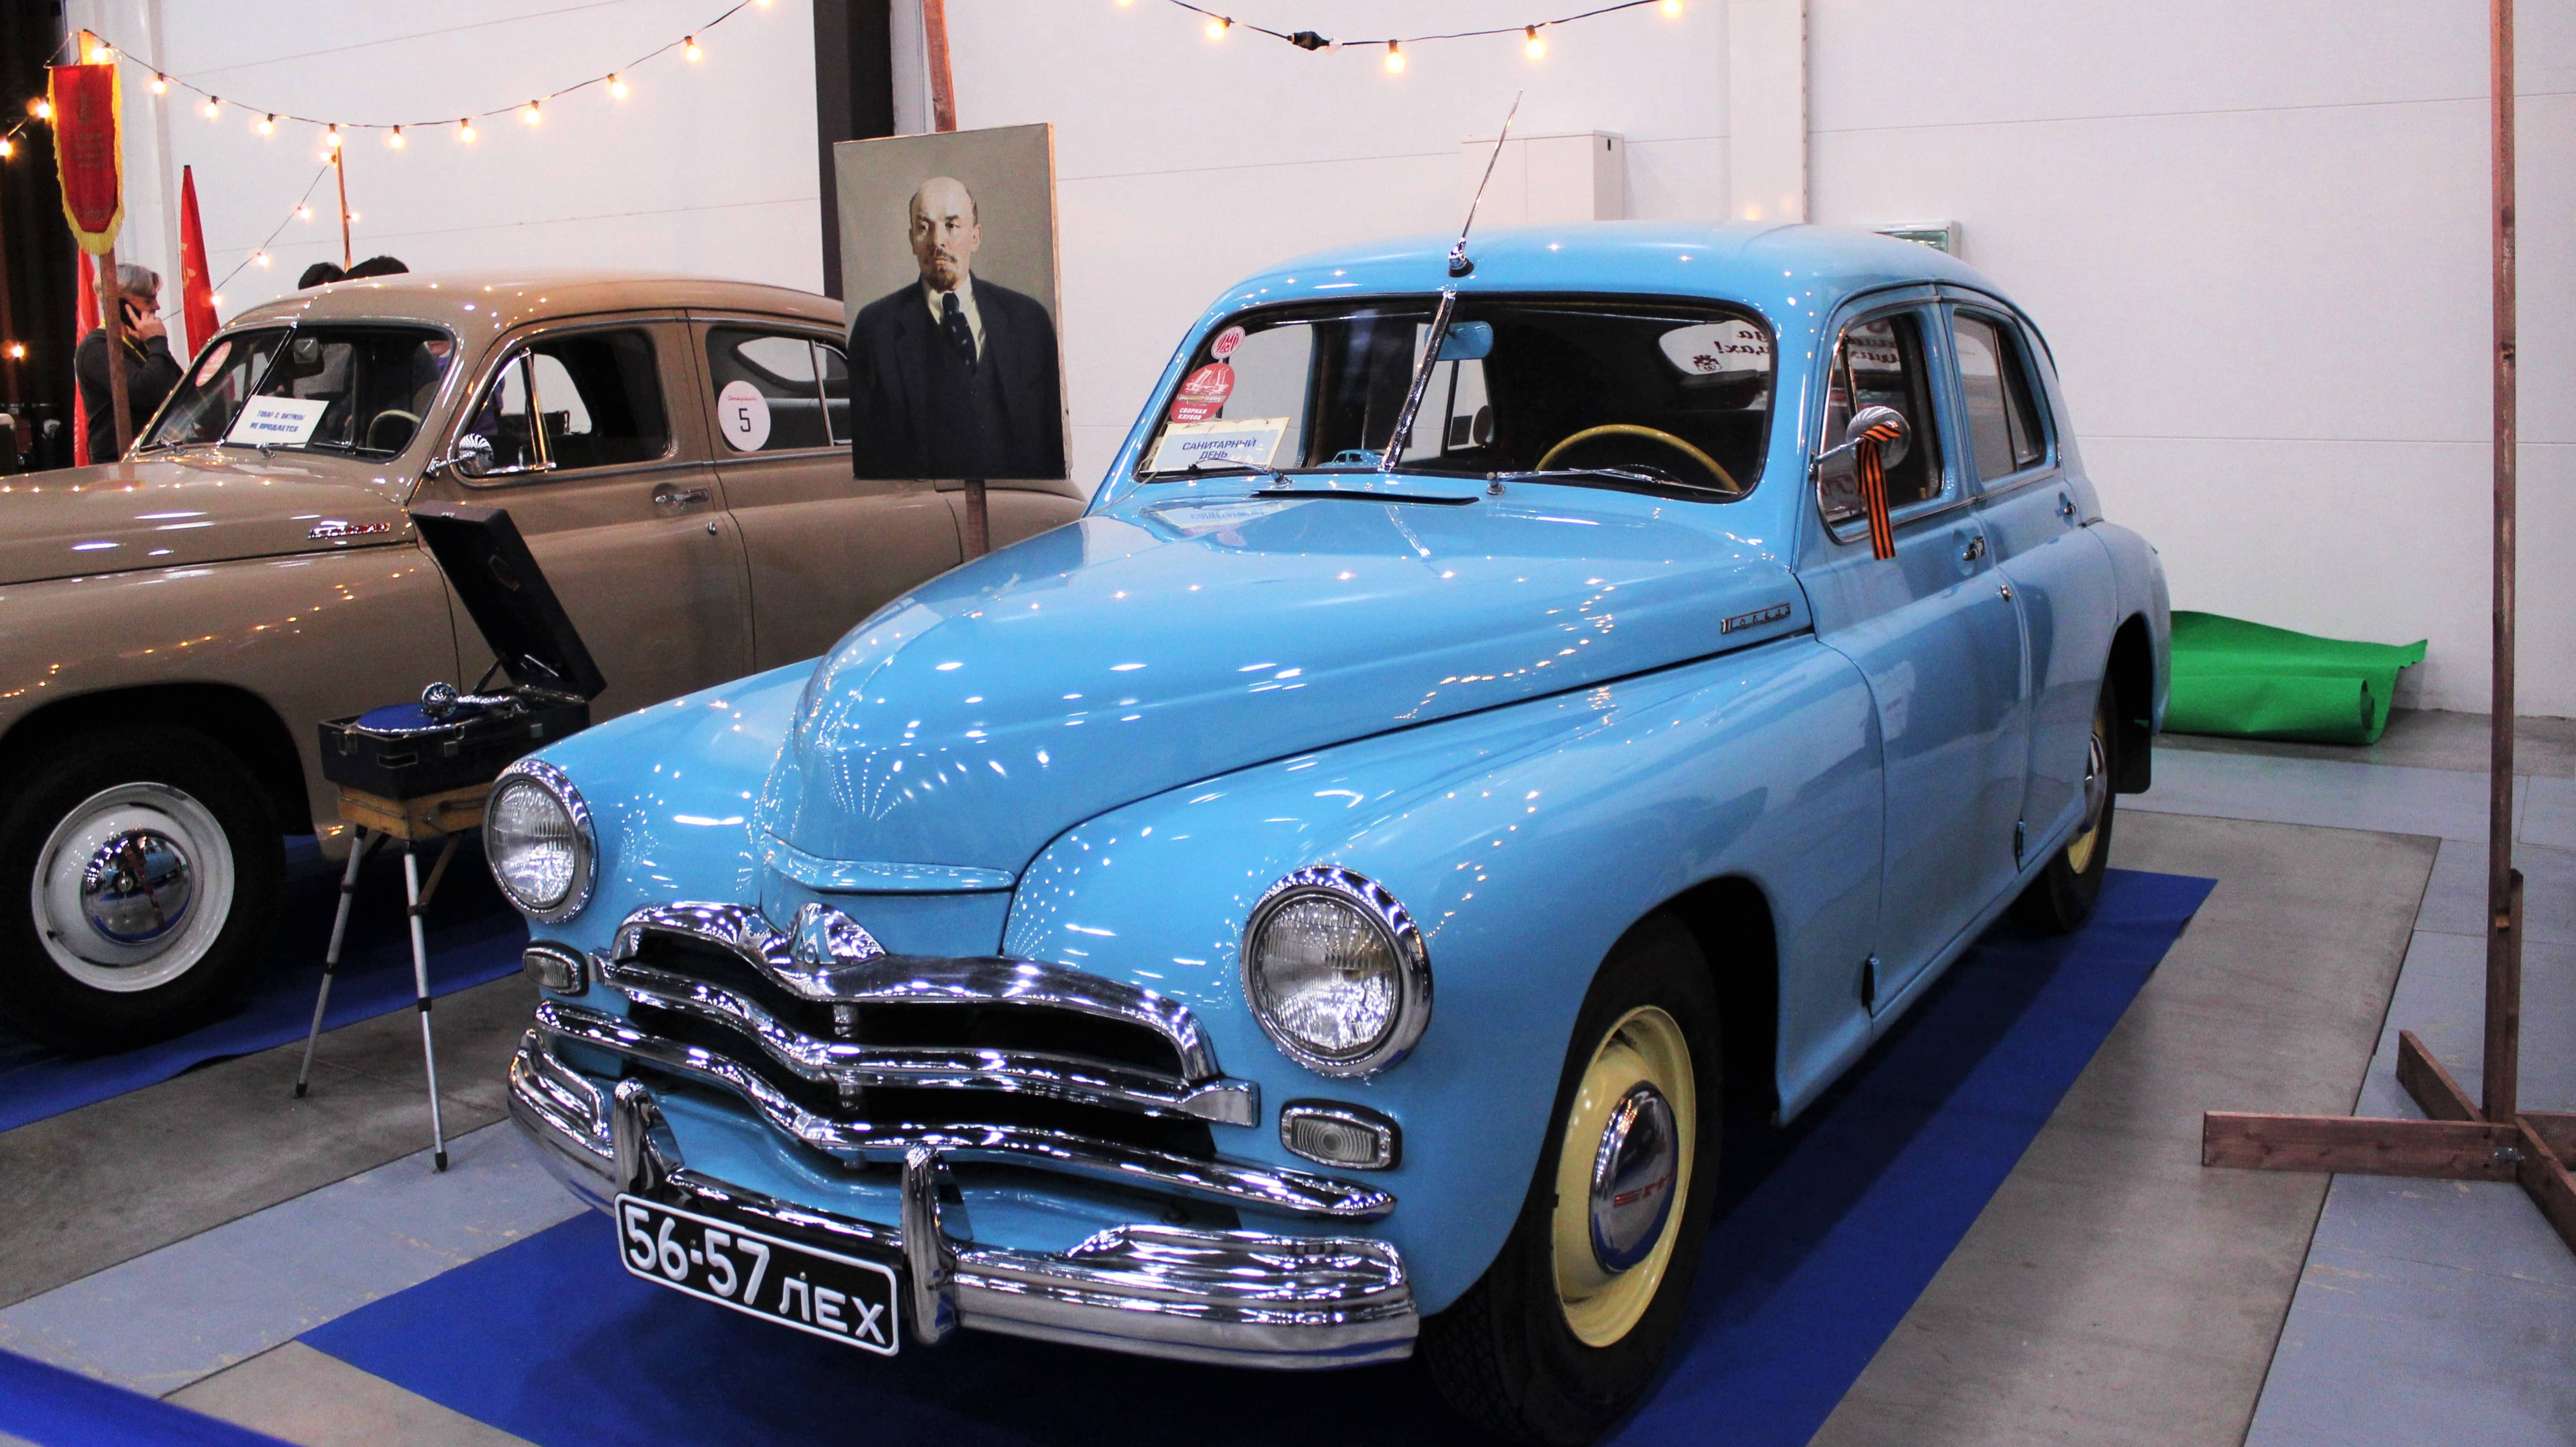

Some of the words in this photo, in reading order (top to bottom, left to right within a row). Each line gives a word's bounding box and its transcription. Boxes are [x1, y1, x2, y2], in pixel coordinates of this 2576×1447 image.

[738, 408, 751, 432] 5
[1182, 437, 1257, 450] САНИТАРНЫЙ
[1199, 450, 1228, 460] ДЕНЬ
[625, 1204, 770, 1305] 56-57
[779, 1277, 885, 1345] ЛЕХ
